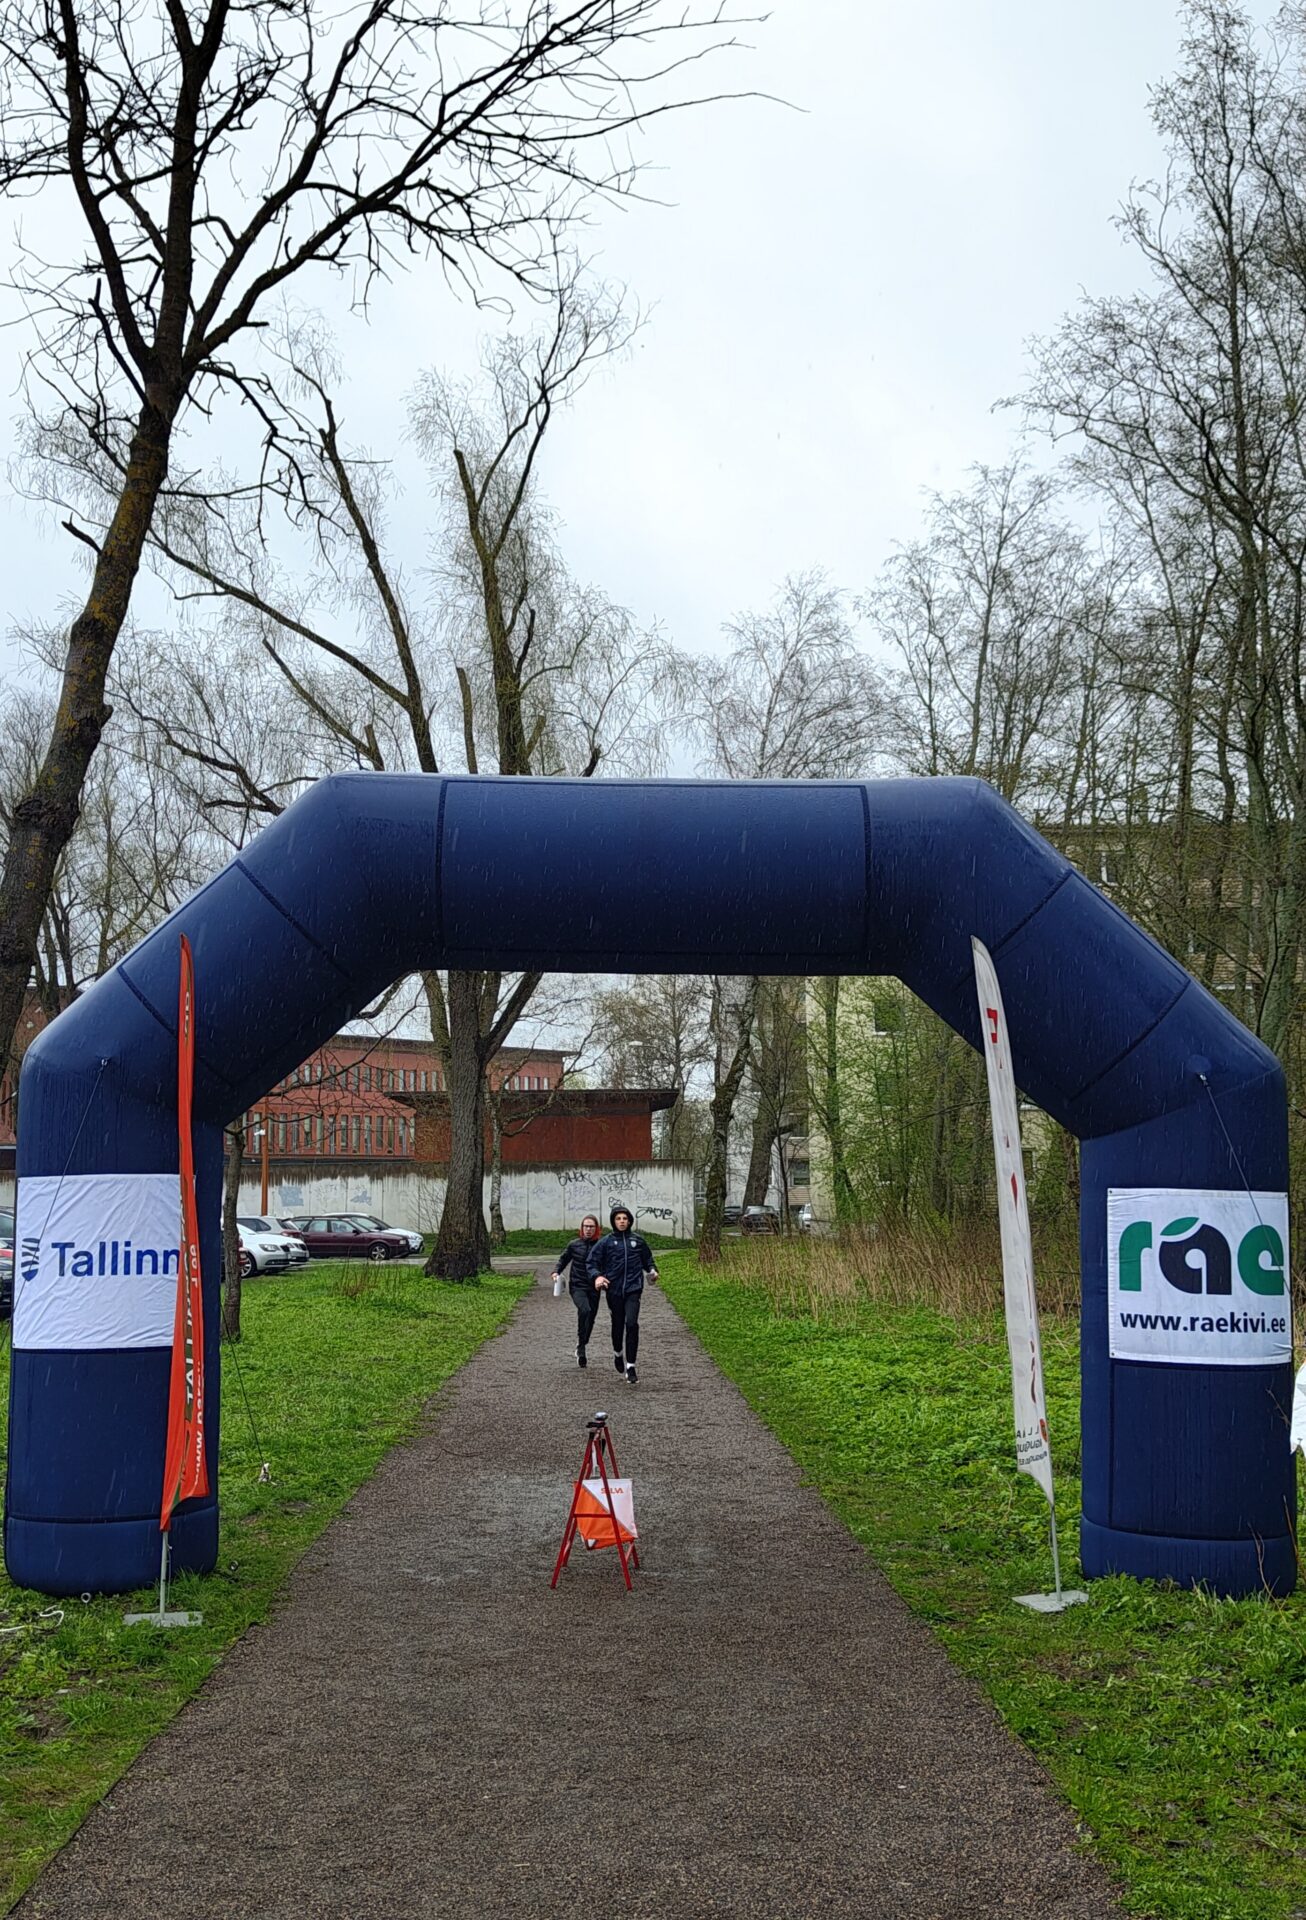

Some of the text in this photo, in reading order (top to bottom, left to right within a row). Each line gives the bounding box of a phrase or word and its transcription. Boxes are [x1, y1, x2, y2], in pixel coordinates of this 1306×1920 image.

[51, 1240, 180, 1277] Tallinn
[1119, 1217, 1284, 1296] rae
[1120, 1312, 1286, 1333] www.raekivi.ee
